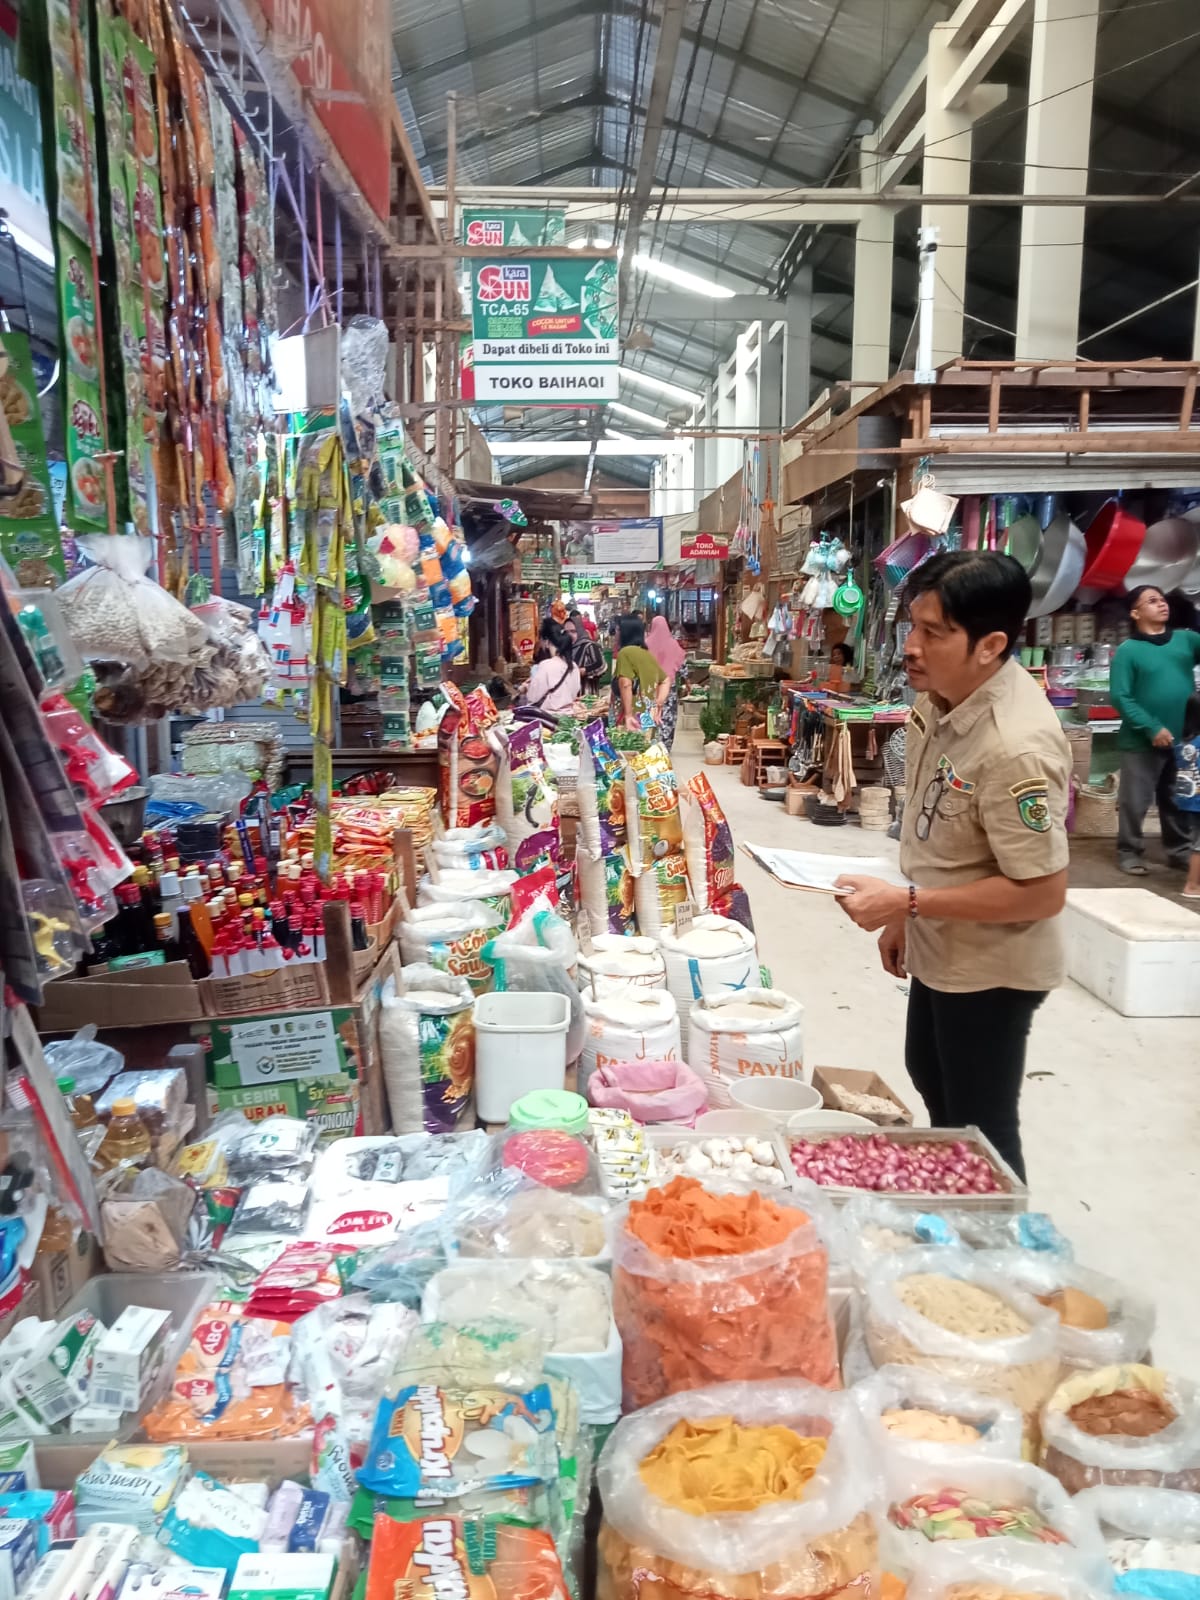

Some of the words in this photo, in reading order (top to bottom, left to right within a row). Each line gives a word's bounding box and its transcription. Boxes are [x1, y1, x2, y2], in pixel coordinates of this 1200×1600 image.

[468, 222, 503, 245] SUN
[505, 267, 526, 279] kara
[479, 266, 530, 300] SUN
[480, 303, 529, 316] TCA-65
[483, 343, 516, 356] Dapat
[519, 343, 549, 354] dibeli
[552, 343, 562, 354] di
[565, 343, 592, 354] Toko
[595, 343, 610, 354] ini
[489, 376, 533, 389] TOKO
[539, 376, 604, 389] BAIHAQI
[232, 1088, 281, 1106] LEBIH
[243, 1104, 287, 1120] URAH
[203, 1320, 227, 1355] ABC
[190, 1380, 209, 1397] BC
